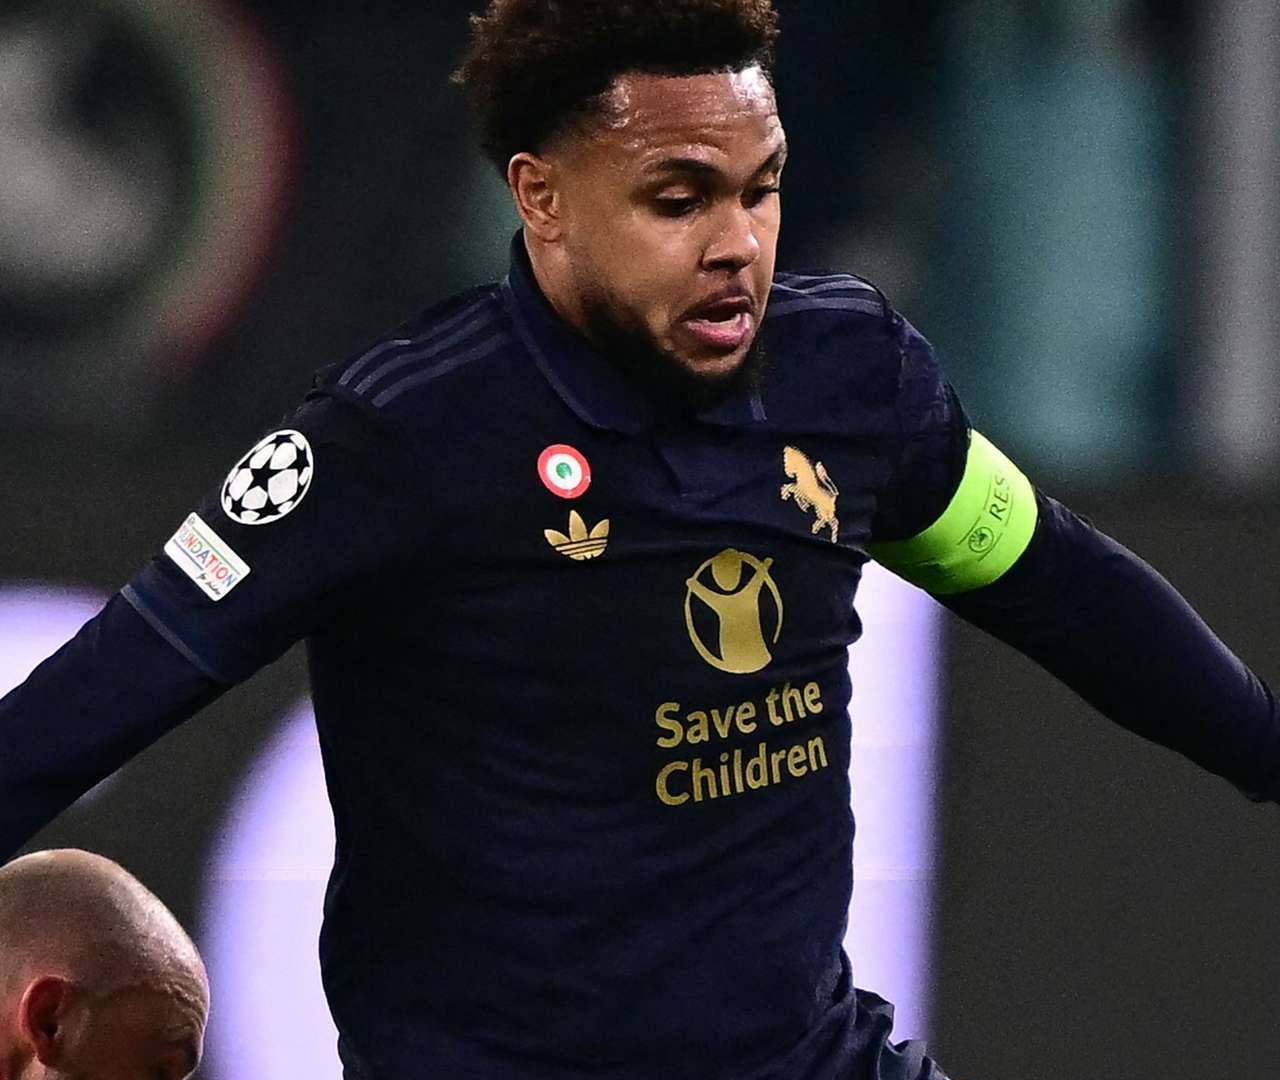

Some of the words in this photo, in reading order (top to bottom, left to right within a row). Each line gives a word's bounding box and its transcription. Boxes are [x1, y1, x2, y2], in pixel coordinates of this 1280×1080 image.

[654, 701, 757, 749] Save
[765, 680, 825, 726] the
[655, 735, 829, 807] Children
